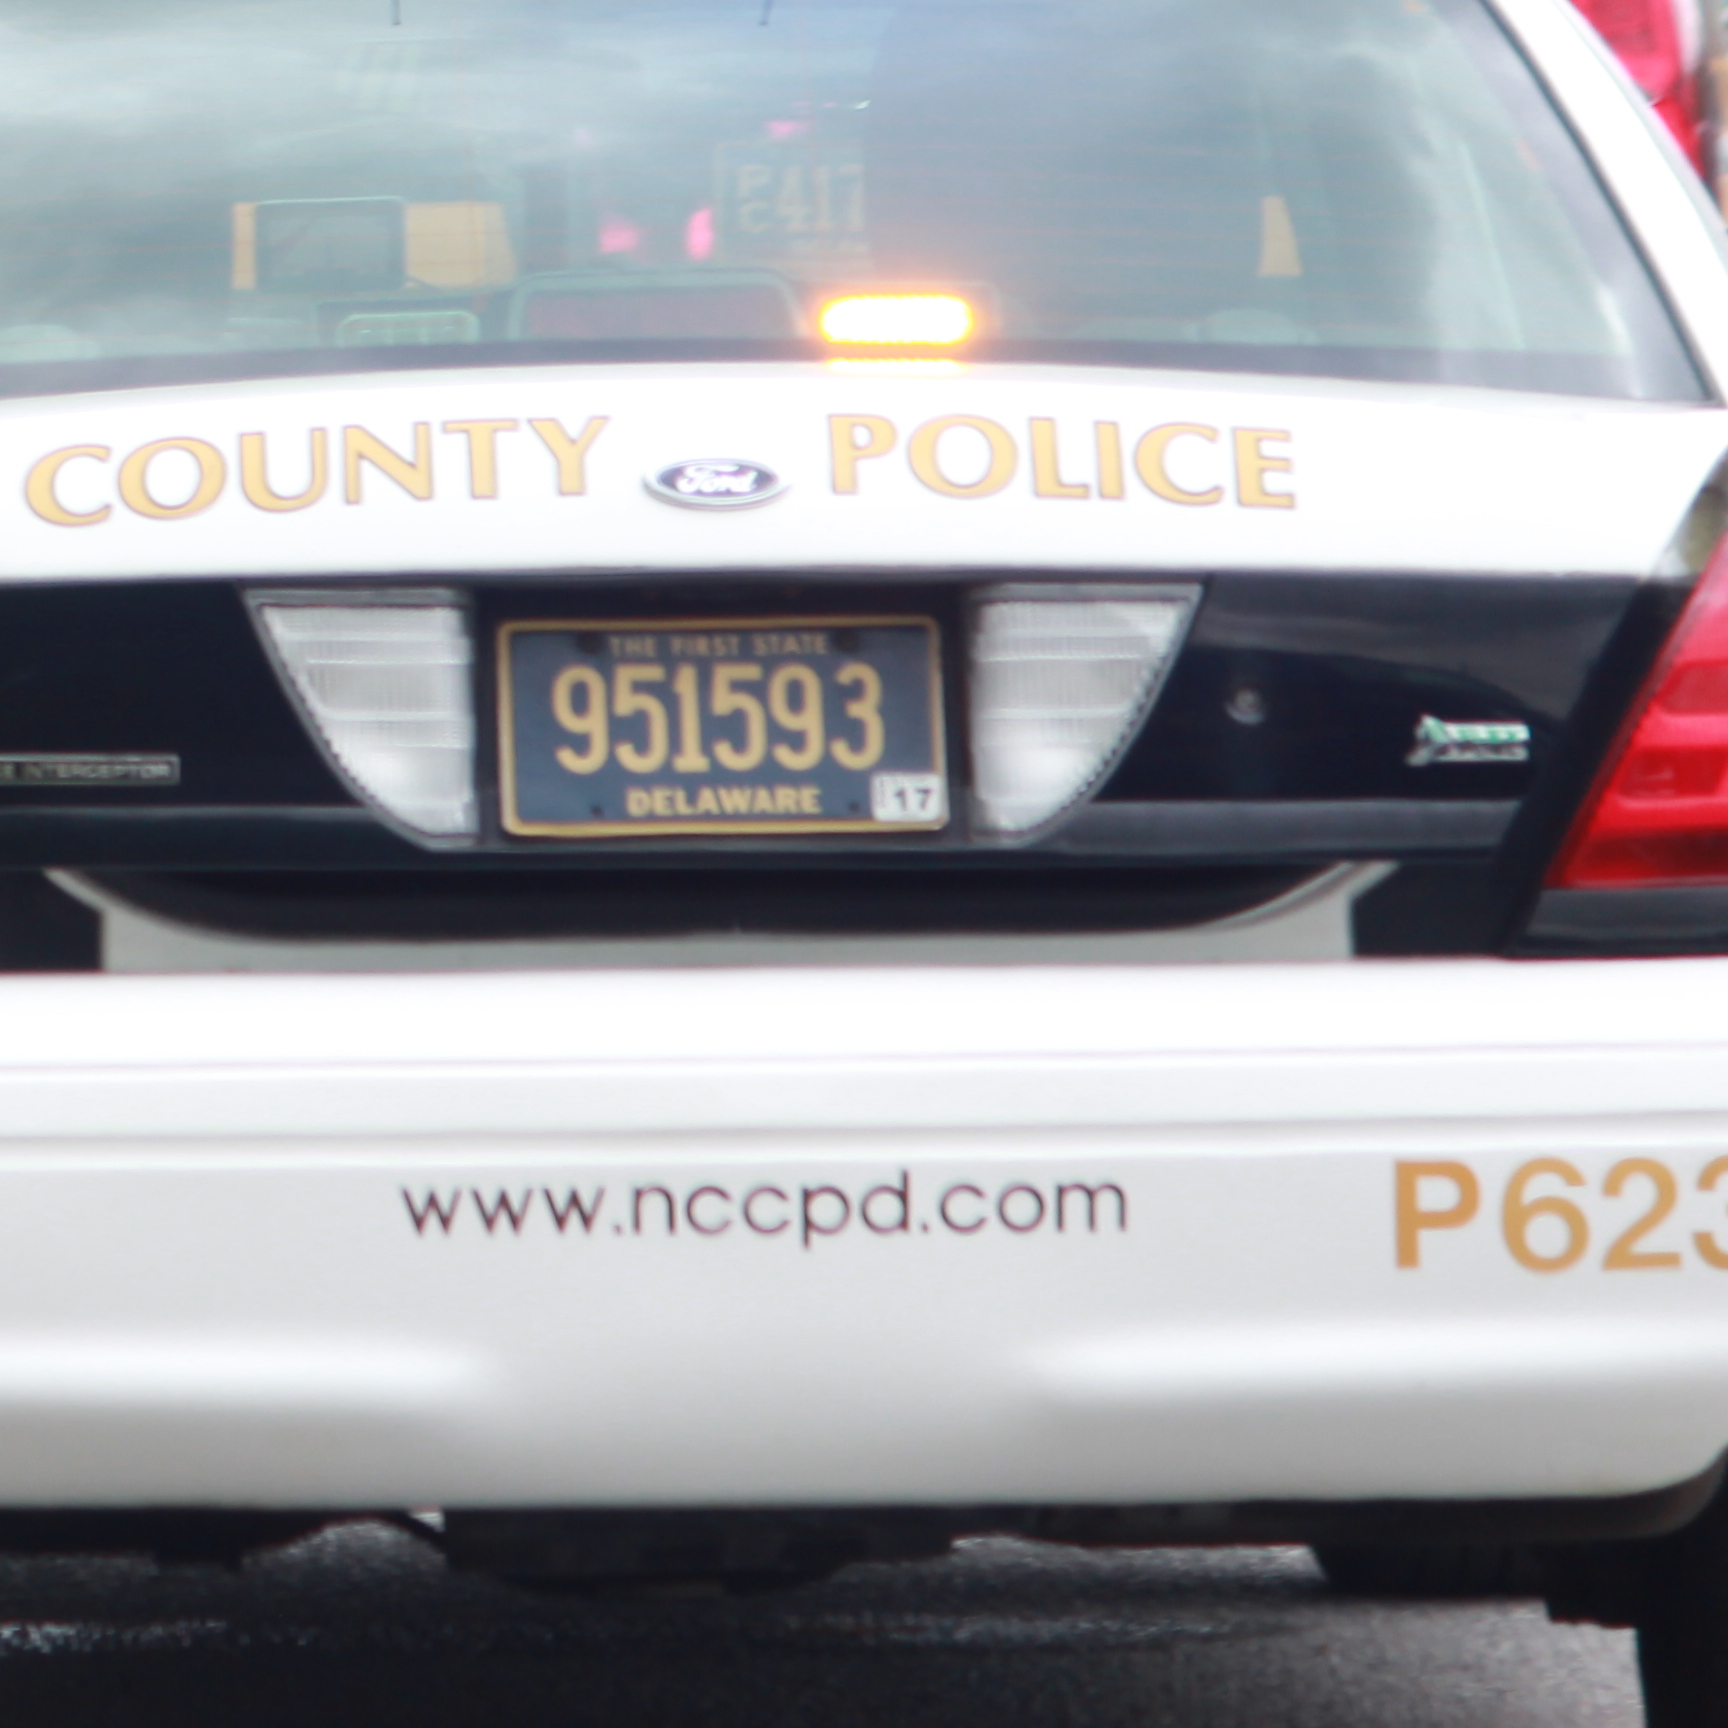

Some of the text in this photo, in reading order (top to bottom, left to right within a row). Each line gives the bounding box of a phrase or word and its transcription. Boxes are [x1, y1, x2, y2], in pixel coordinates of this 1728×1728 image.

[24, 413, 1297, 527] COUNTY POLICE
[675, 464, 758, 494] Ford
[608, 631, 829, 658] THE FIRST STATE
[551, 660, 886, 775] 951593
[625, 786, 823, 817] DELAWARE
[893, 787, 933, 814] 17
[401, 1170, 1127, 1249] www.nccpd.com
